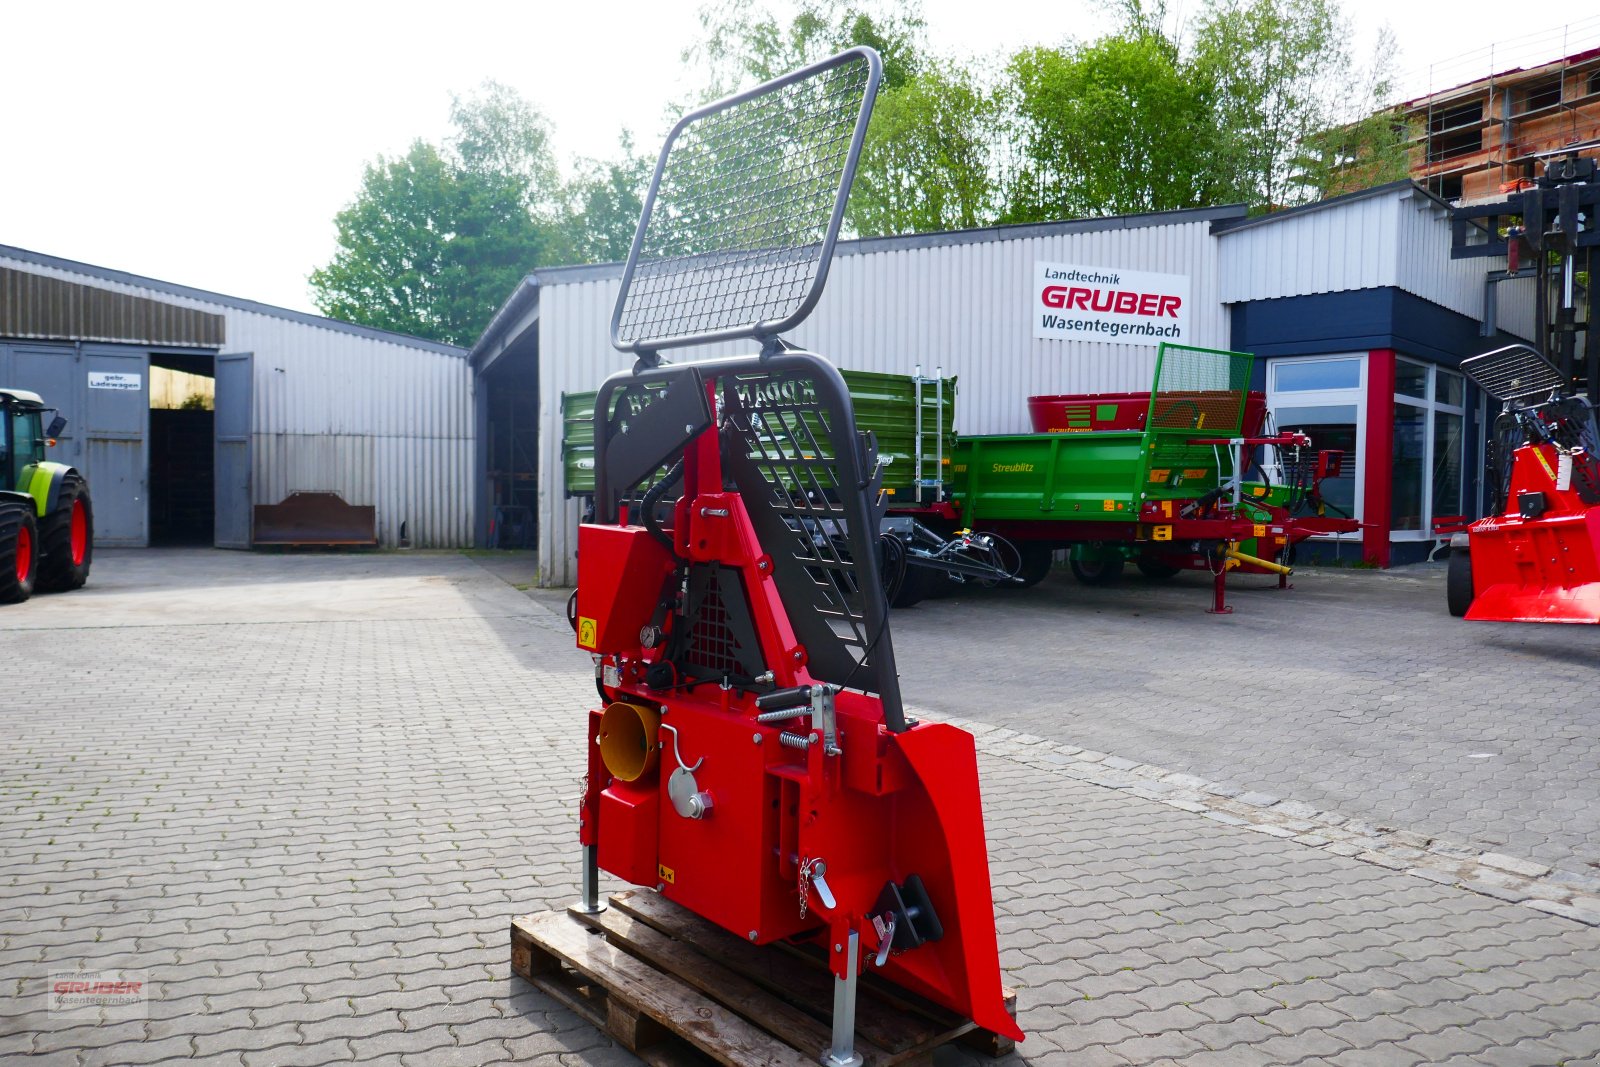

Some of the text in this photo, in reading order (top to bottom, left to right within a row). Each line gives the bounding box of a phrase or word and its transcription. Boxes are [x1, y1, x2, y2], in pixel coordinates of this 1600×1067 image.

[1045, 268, 1120, 285] Landtechnik
[1041, 285, 1182, 318] GRUBER
[1042, 315, 1181, 338] Wasentegernbach
[91, 381, 139, 389] Ladewagen
[992, 462, 1034, 473] Streublitz
